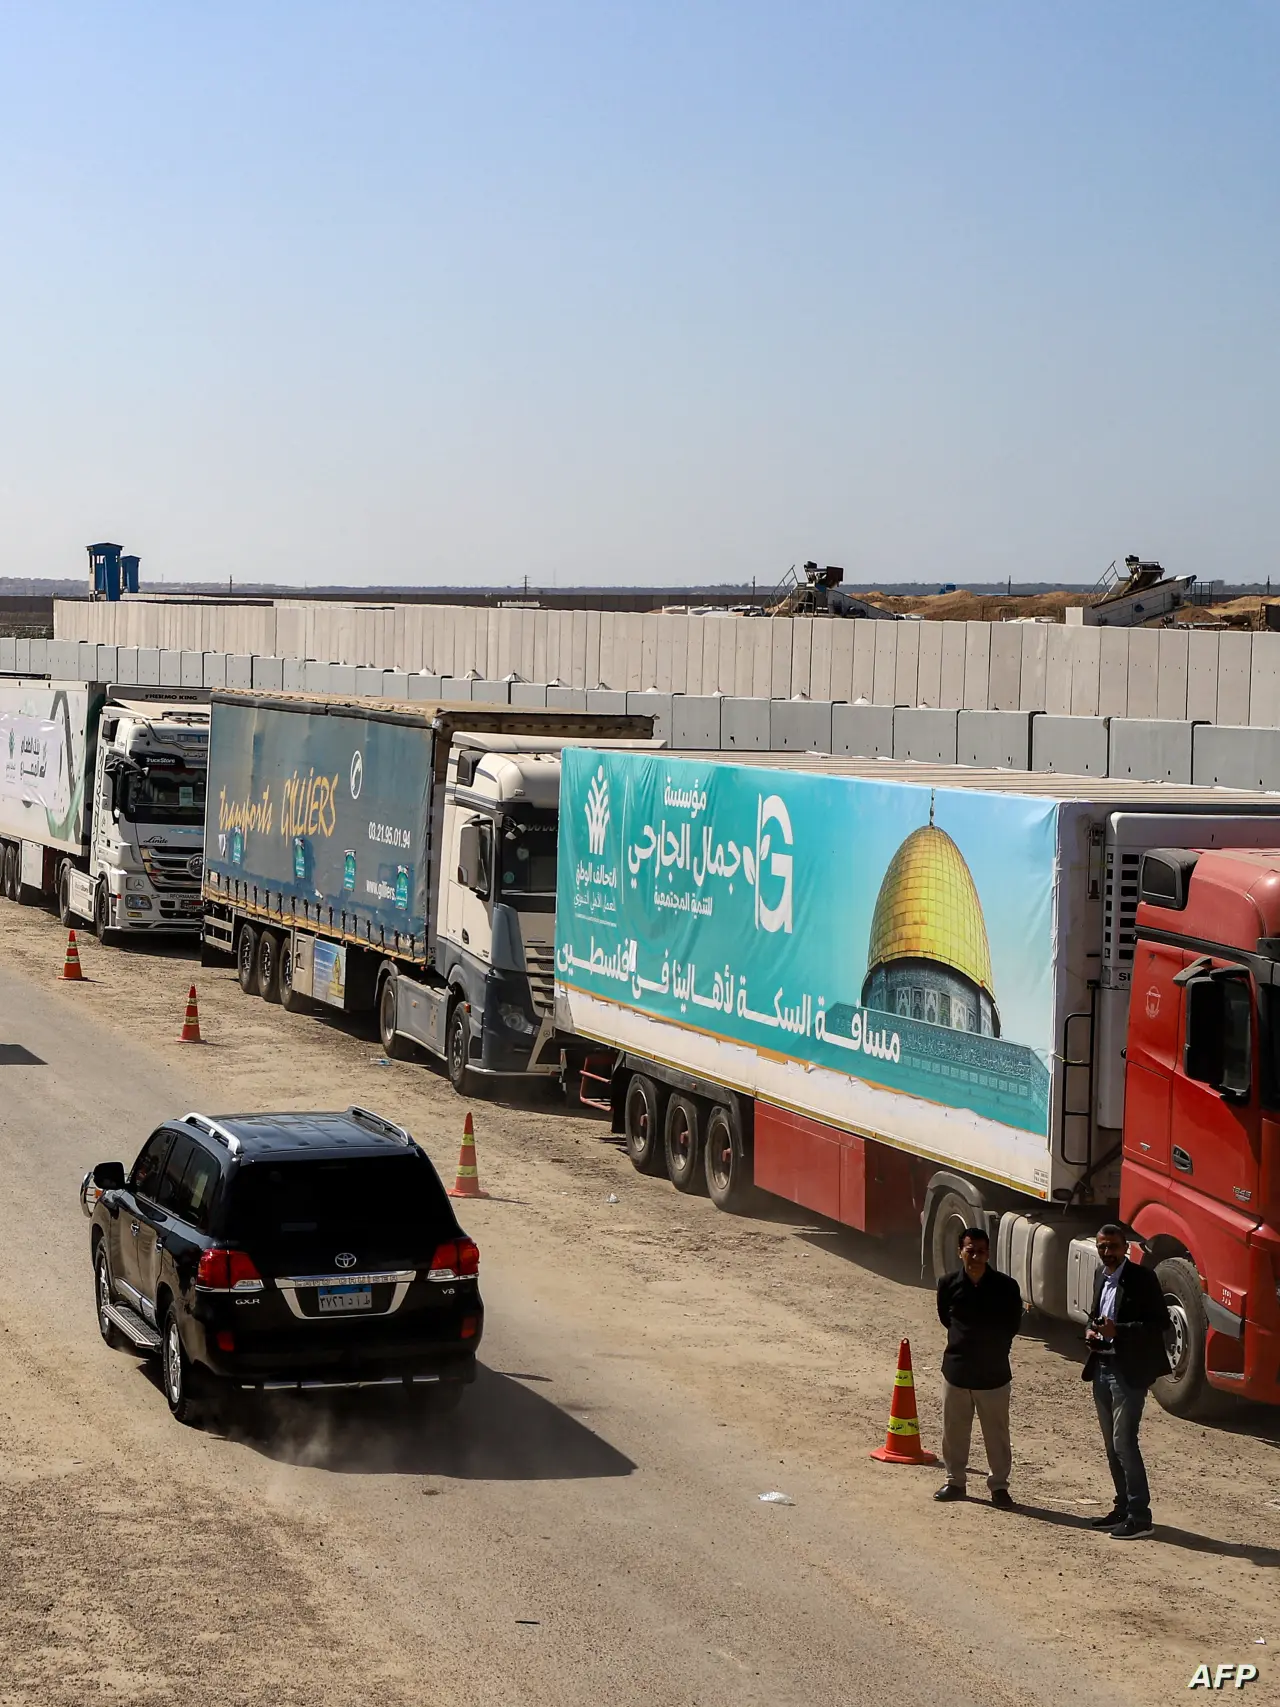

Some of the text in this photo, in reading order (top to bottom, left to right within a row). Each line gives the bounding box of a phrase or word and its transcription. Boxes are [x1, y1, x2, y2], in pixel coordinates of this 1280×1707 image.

[664, 775, 707, 818] مؤسسة
[628, 820, 741, 895] جمال الجارحي
[654, 885, 690, 915] المجتمعية
[557, 936, 630, 982] فلسطين
[673, 960, 734, 1014] لأهالينا
[737, 975, 811, 1037] السكة
[815, 996, 900, 1063] مسافة
